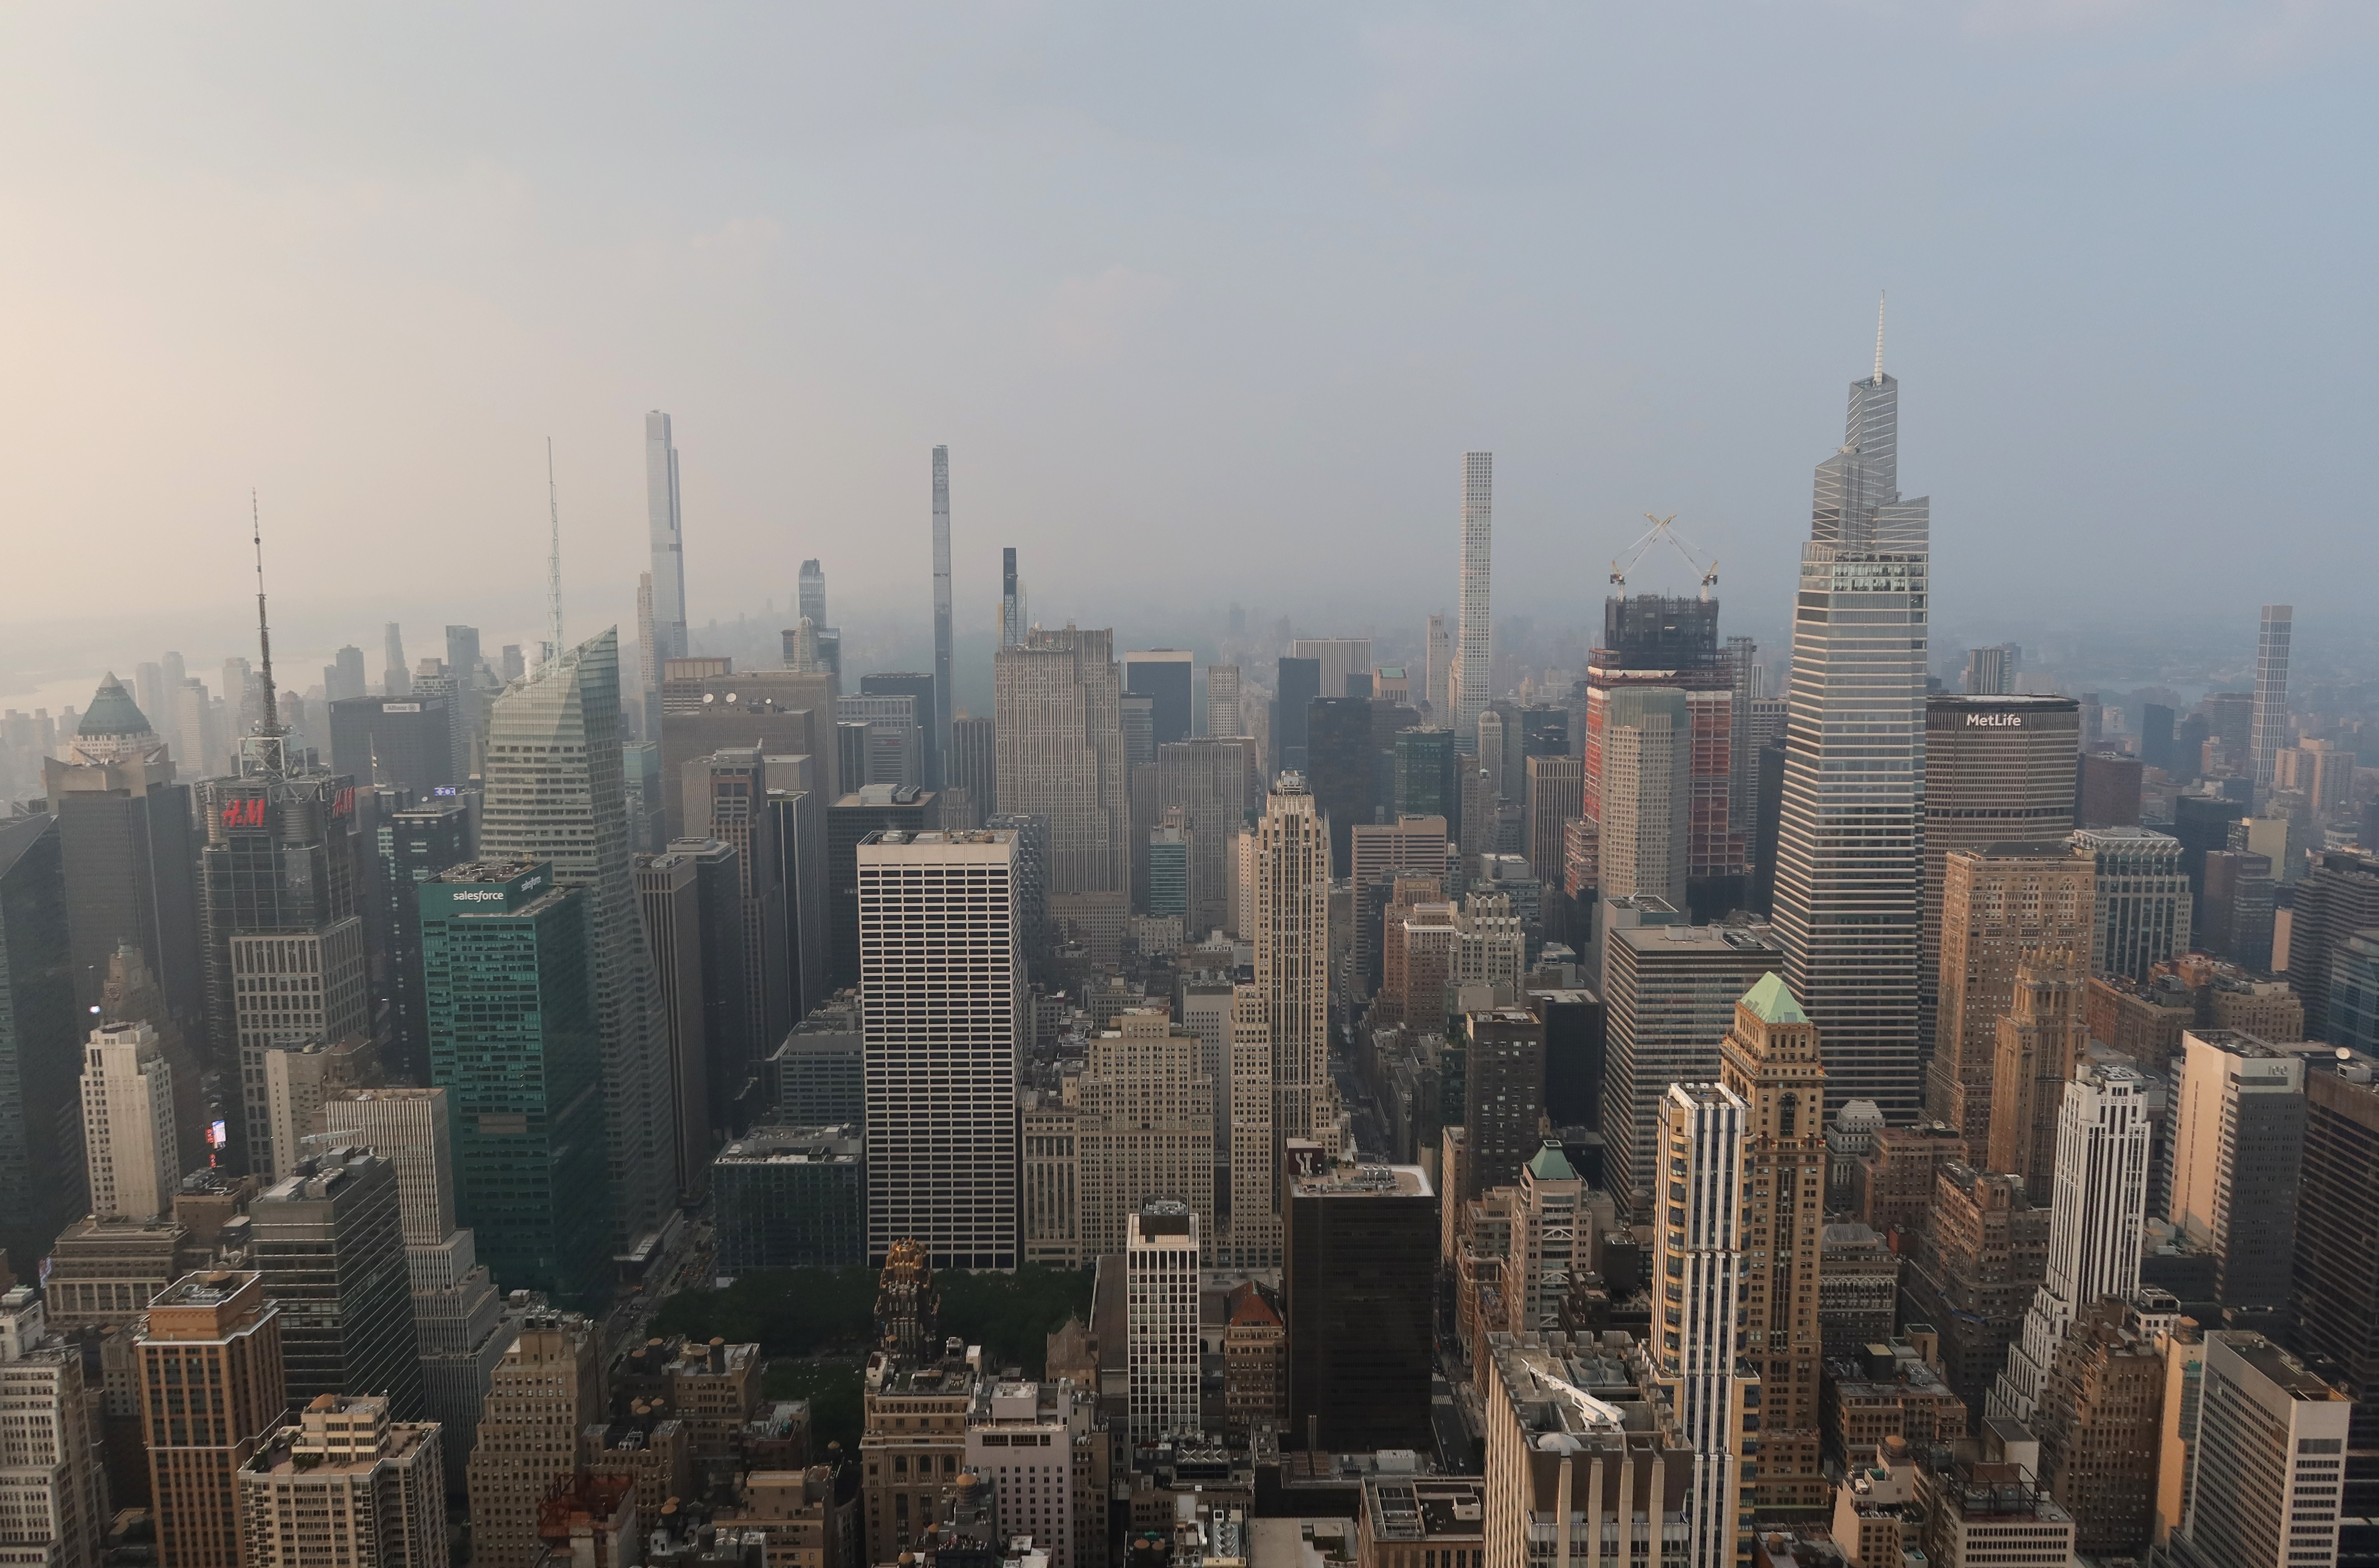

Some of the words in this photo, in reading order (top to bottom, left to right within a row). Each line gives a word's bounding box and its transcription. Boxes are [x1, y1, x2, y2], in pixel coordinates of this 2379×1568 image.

[1967, 714, 2021, 726] MetLife
[221, 799, 265, 826] H&M
[453, 890, 504, 903] salesforce
